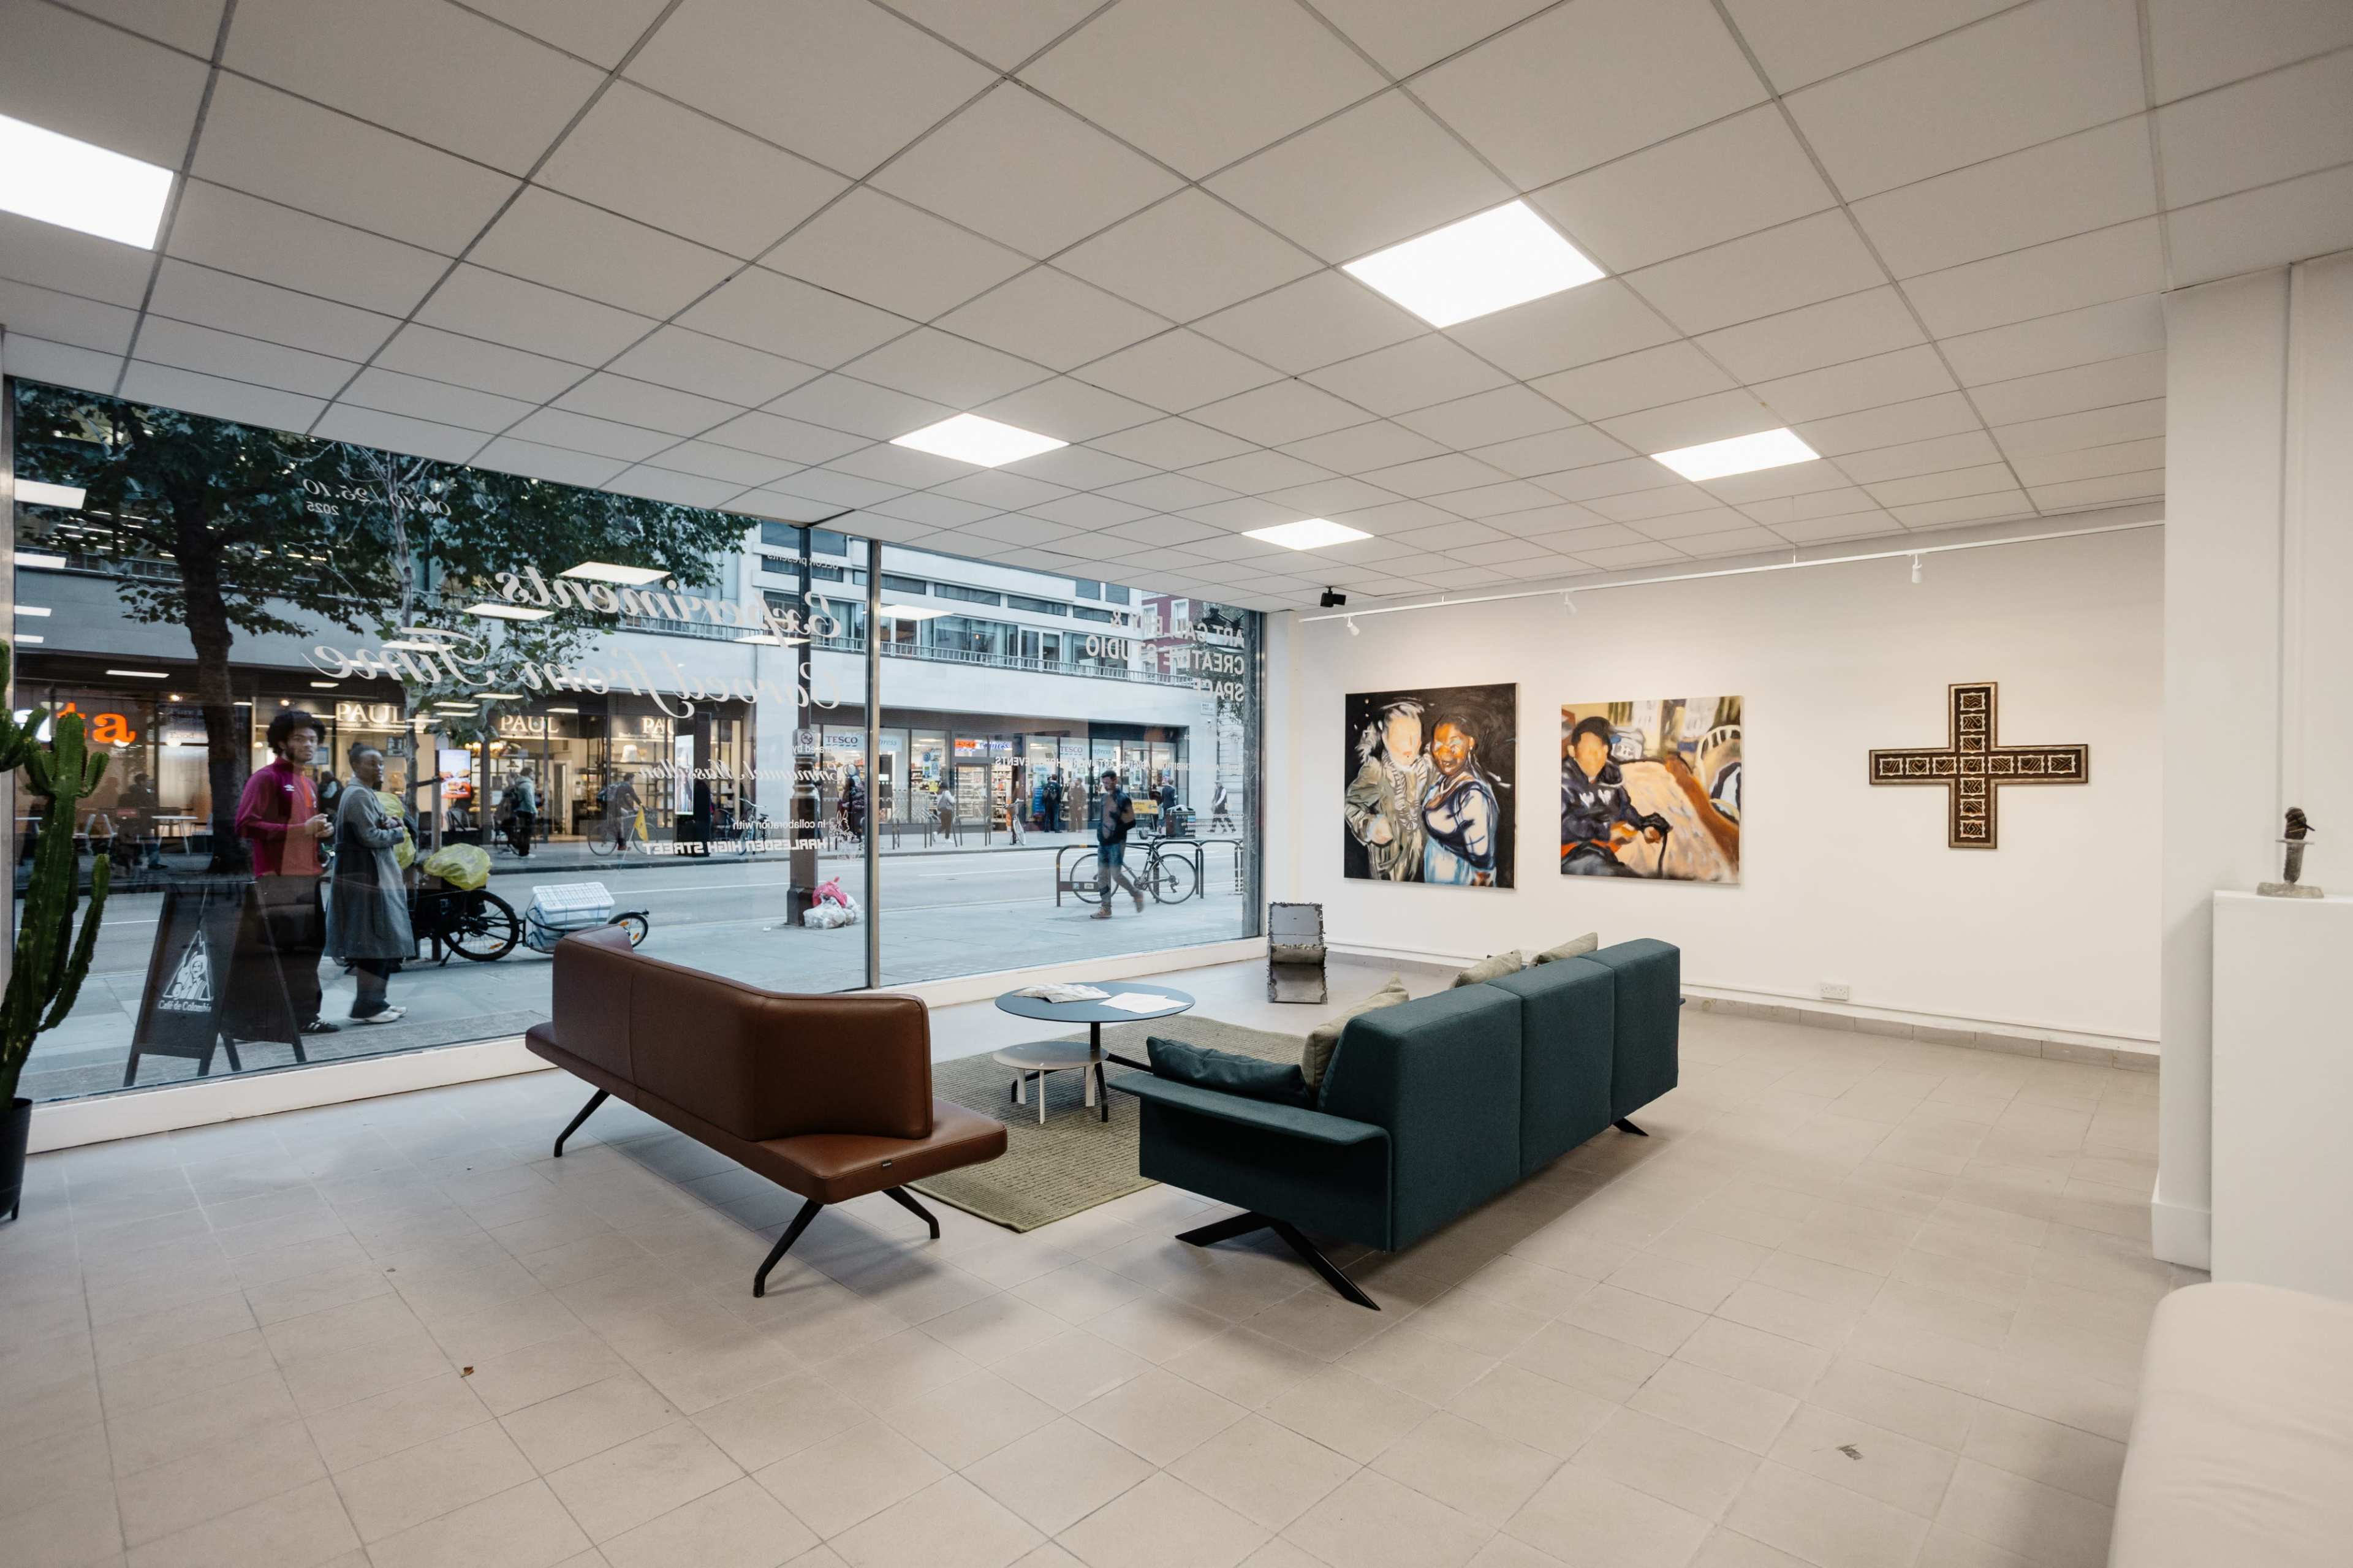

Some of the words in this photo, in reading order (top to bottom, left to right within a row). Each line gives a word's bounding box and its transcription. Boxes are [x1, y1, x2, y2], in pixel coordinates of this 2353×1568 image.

[336, 703, 406, 724] PAUL
[500, 715, 559, 733] PAUL
[174, 1001, 181, 1010] de
